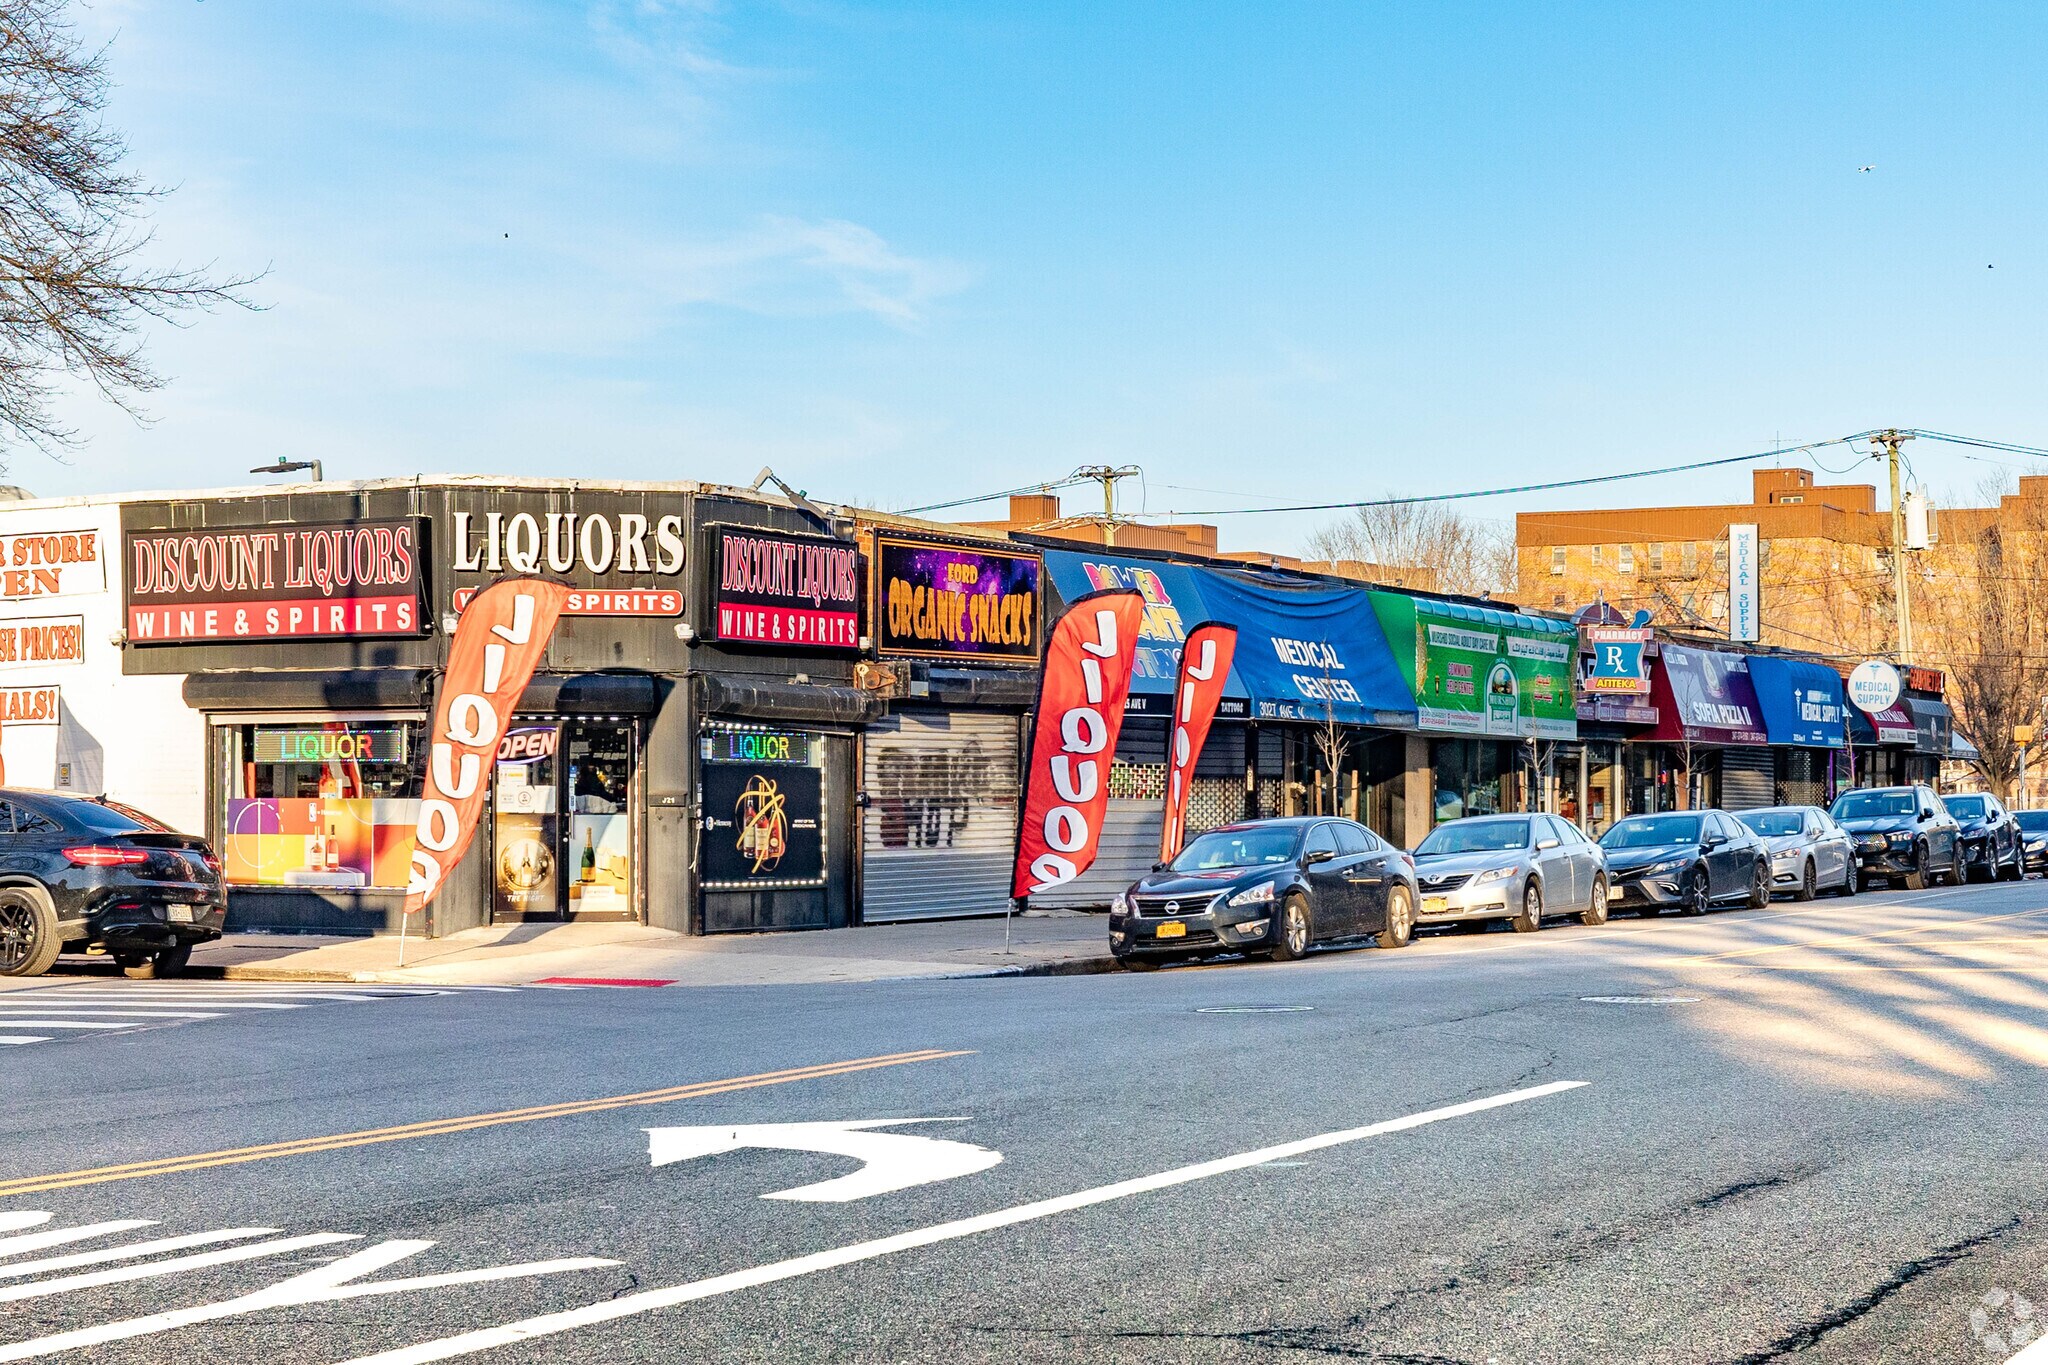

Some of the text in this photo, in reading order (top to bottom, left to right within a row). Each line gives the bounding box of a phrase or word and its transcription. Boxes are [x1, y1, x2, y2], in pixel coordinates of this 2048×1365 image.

[13, 533, 96, 567] STORE
[453, 511, 685, 574] LIQUORS
[133, 526, 412, 597] DISCOUNT LIQUORS
[722, 535, 856, 608] DISCOUNT LIQUORS
[947, 562, 978, 585] FORD
[0, 567, 62, 597] EN
[1737, 533, 1750, 639] MEDICAL SUPPLY
[567, 594, 676, 611] SPIRITS
[889, 576, 1032, 647] ORGANIC SNACKS
[135, 602, 412, 638] WINE & SPIRITS
[722, 609, 855, 644] WINE & SPIRITS
[21, 624, 82, 661] PRICES!
[1594, 630, 1643, 640] PHARMACY
[1271, 636, 1346, 670] MEDICAL
[1605, 646, 1628, 674] Rx
[1292, 674, 1362, 703] CENTER
[1595, 678, 1636, 689] АПТЕКА
[1855, 681, 1893, 692] MEDICAL
[1259, 701, 1276, 717] 3027
[1693, 701, 1721, 723] SOFIA
[1718, 704, 1746, 725] PIZZA
[1802, 702, 1840, 724] MEDICAL SUPPLY
[1857, 693, 1891, 705] SUPPLY
[280, 734, 374, 761] LIQUOR
[497, 732, 557, 760] OPEN
[730, 735, 790, 761] LIQUOR
